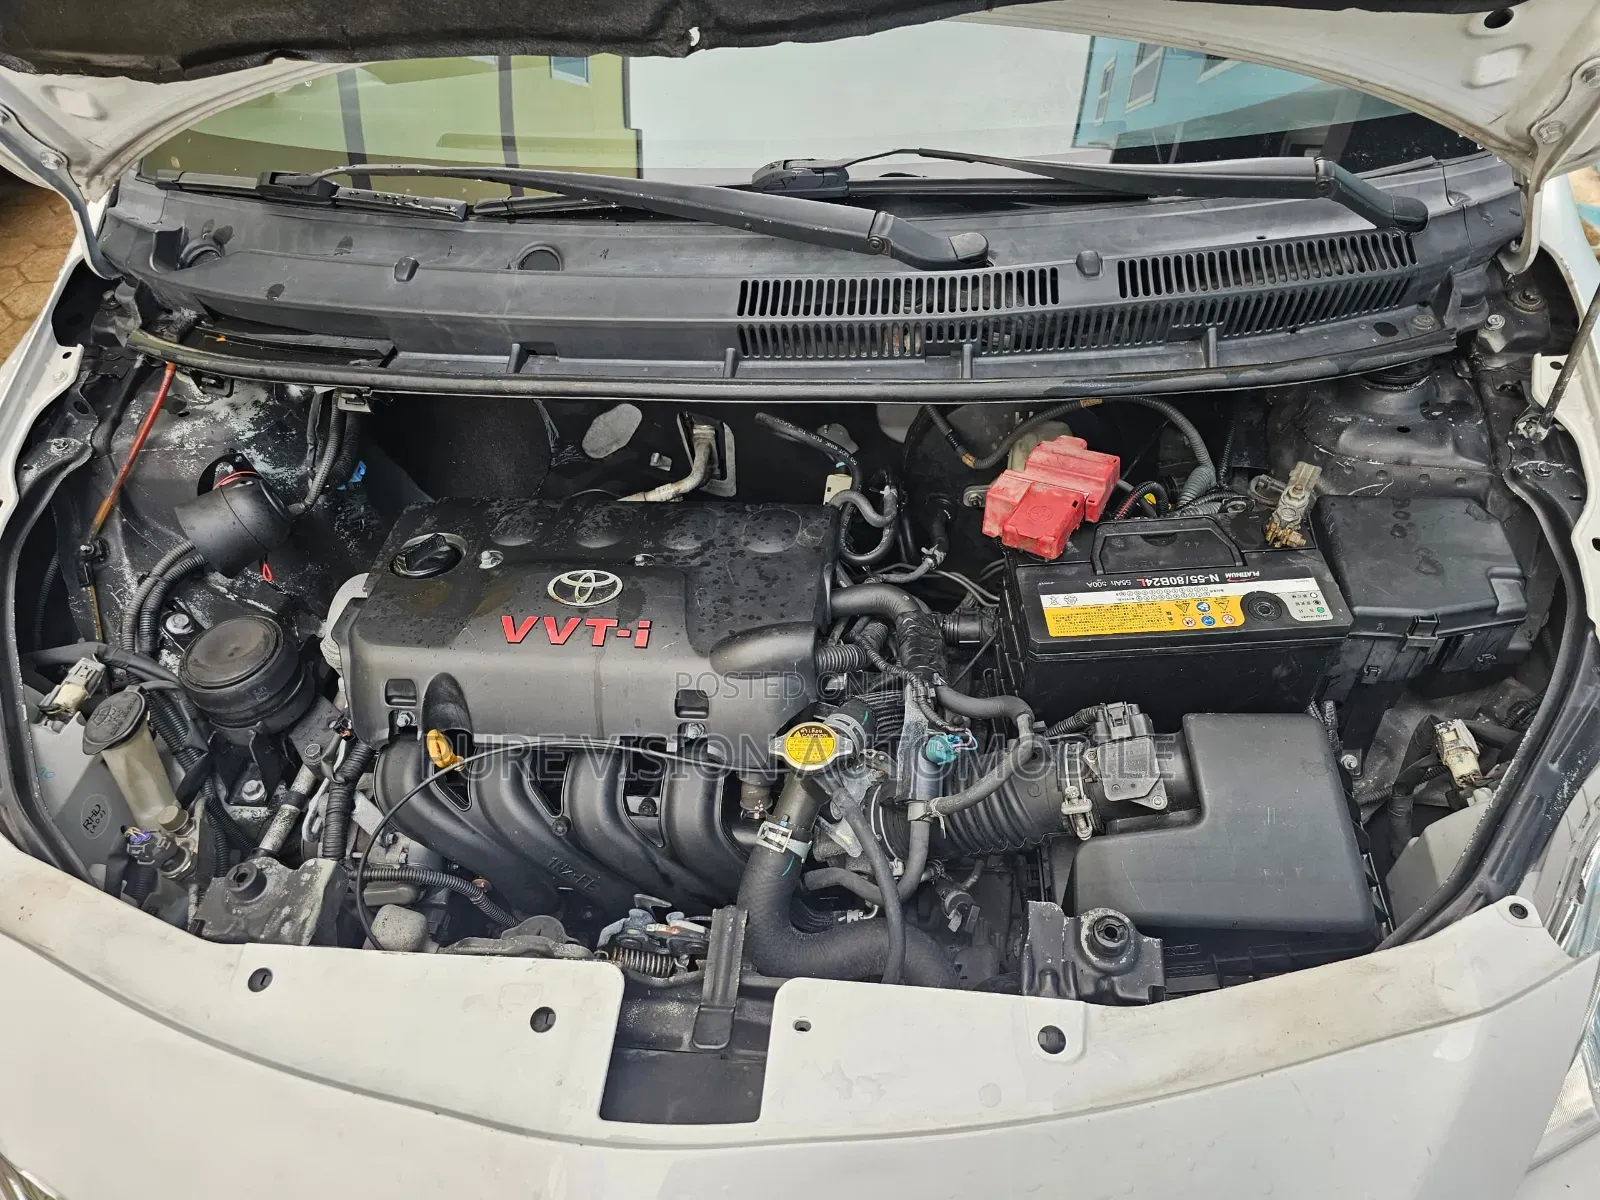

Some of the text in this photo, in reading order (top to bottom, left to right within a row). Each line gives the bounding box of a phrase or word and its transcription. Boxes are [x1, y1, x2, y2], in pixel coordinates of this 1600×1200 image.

[1136, 573, 1220, 588] N-55/80B24L
[1225, 570, 1261, 578] PLATINUM
[501, 615, 652, 649] VVT-i
[83, 803, 101, 830] RHD
